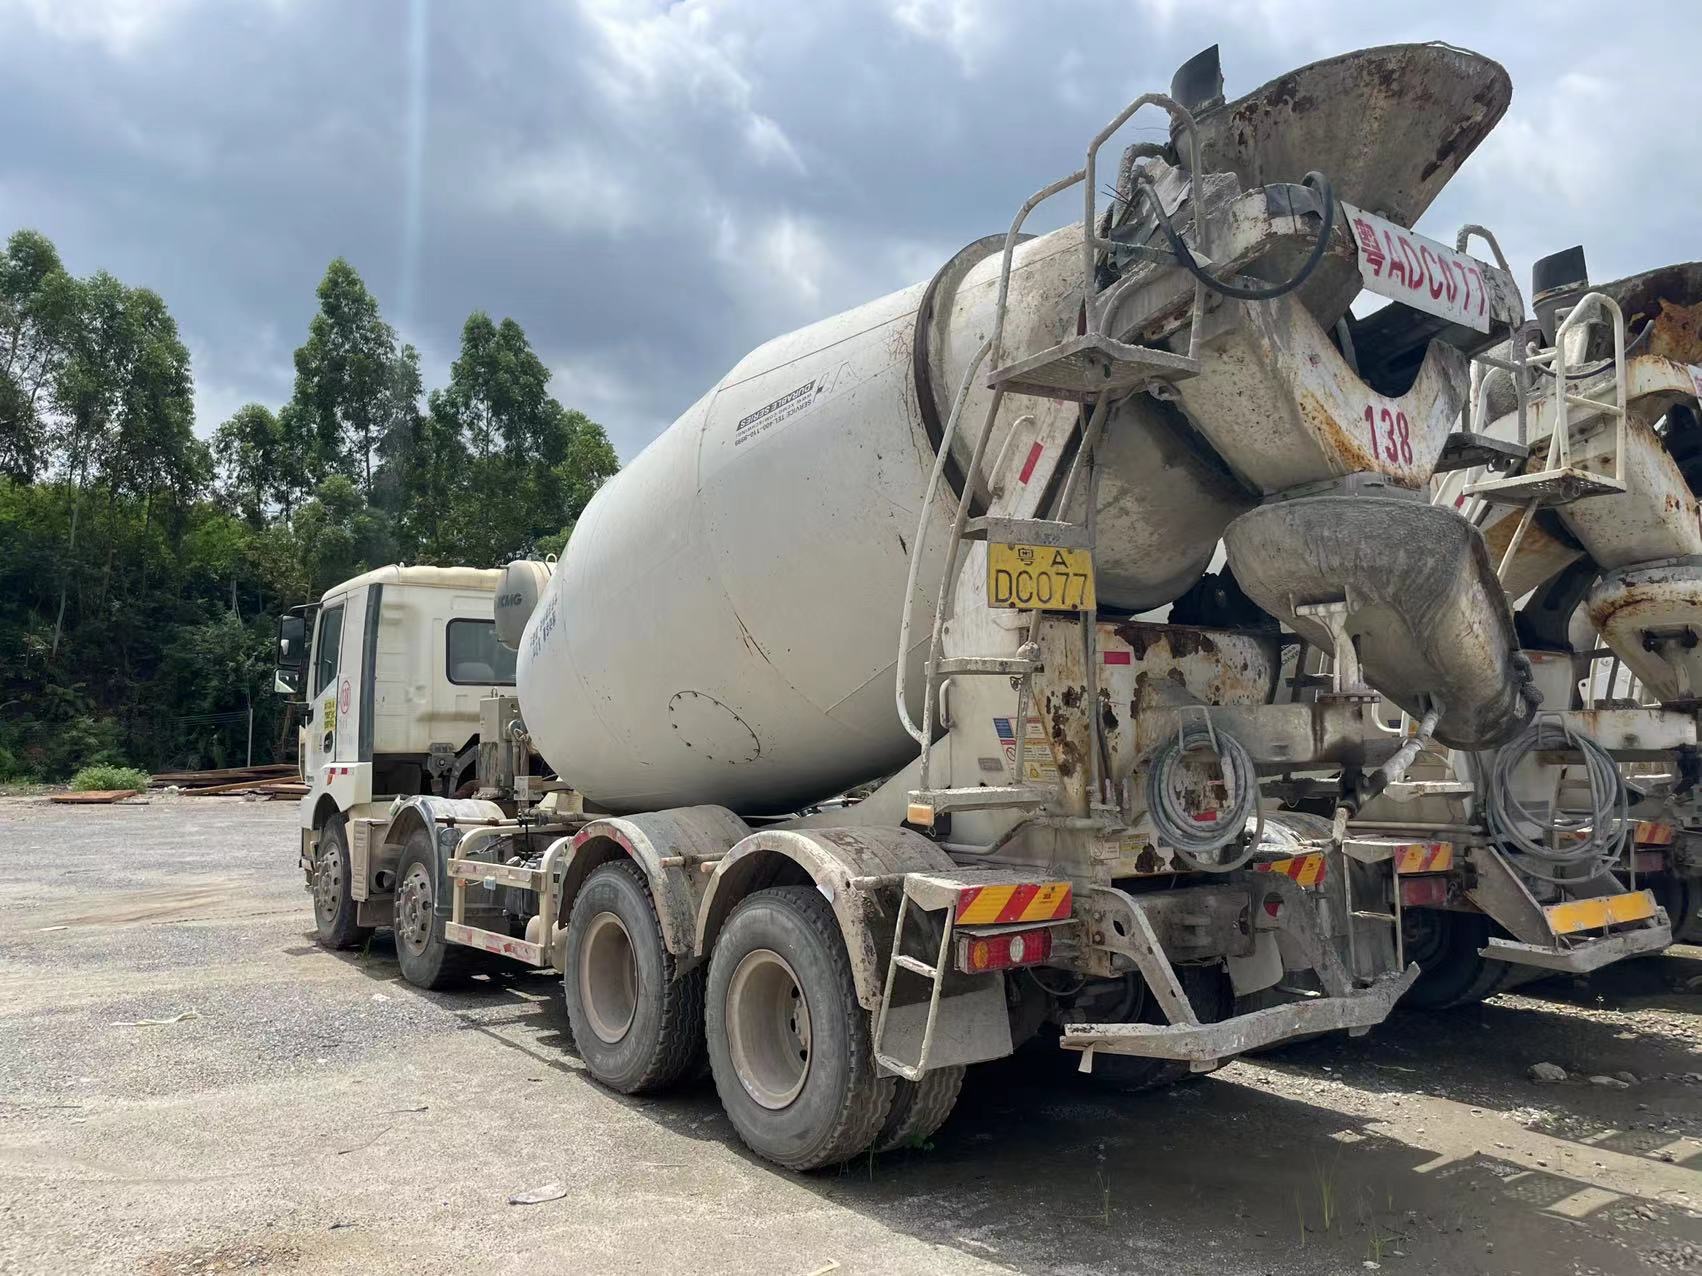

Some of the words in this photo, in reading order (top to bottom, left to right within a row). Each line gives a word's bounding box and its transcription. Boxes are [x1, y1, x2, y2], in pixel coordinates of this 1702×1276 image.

[1353, 218, 1485, 316] 粤ADC077
[1364, 404, 1413, 466] 138
[995, 568, 1088, 605] DC077
